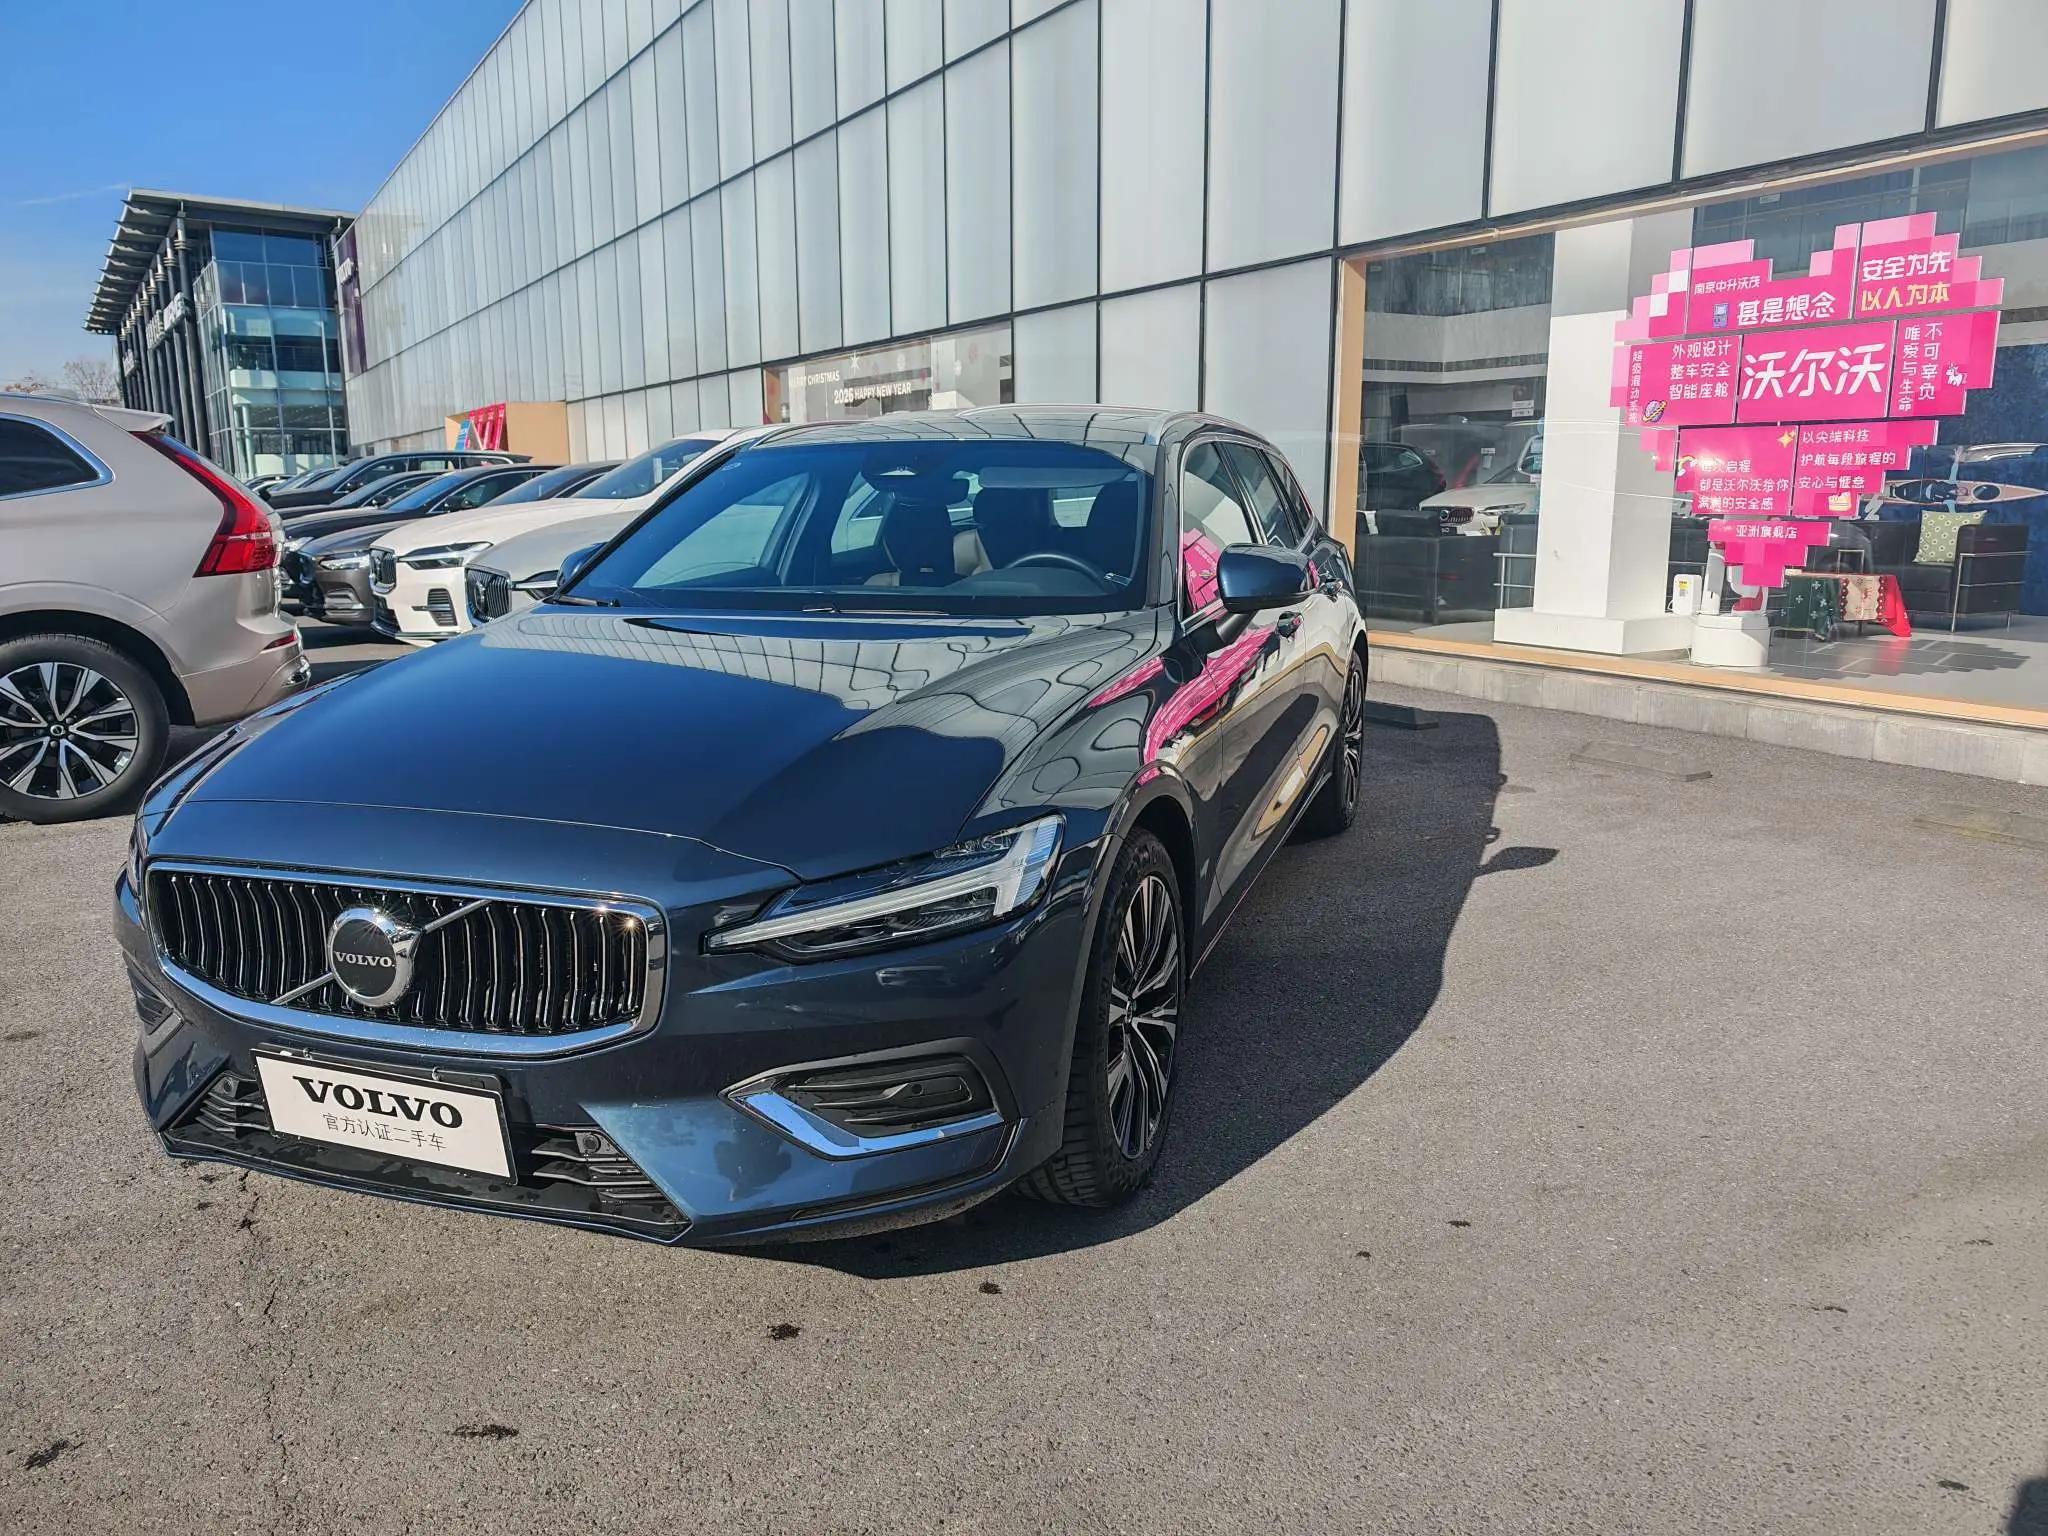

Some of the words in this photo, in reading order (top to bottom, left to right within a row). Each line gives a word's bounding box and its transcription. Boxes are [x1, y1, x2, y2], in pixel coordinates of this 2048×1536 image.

[1862, 251, 1952, 282] 安全为先
[1694, 275, 1761, 295] 南京中升沃茂
[1861, 281, 1951, 312] 以人为本
[1737, 291, 1836, 326] 甚是想念
[1672, 339, 1732, 360] 外观设计
[1670, 361, 1731, 380] 整车安全
[1742, 343, 1886, 400] 沃尔沃
[1898, 325, 1921, 412] 唯爱与生命
[1917, 322, 1943, 401] 不可辜负
[808, 370, 840, 386] CHRISTMAS
[834, 387, 854, 404] 2026
[854, 385, 877, 401] HAPPY
[877, 383, 893, 398] NEW
[893, 381, 912, 395] YEAR
[1669, 382, 1729, 400] 智能座舱
[1802, 429, 1870, 444] 以尖端科技
[1800, 452, 1896, 467] 护航每段旅程的
[1700, 478, 1790, 493] 都是沃尔沃给你
[1735, 525, 1798, 539] 亚洲旗舰店
[333, 951, 393, 968] VOLVO
[292, 1075, 463, 1129] VOLVO
[322, 1112, 447, 1152] 官方认证二手车
